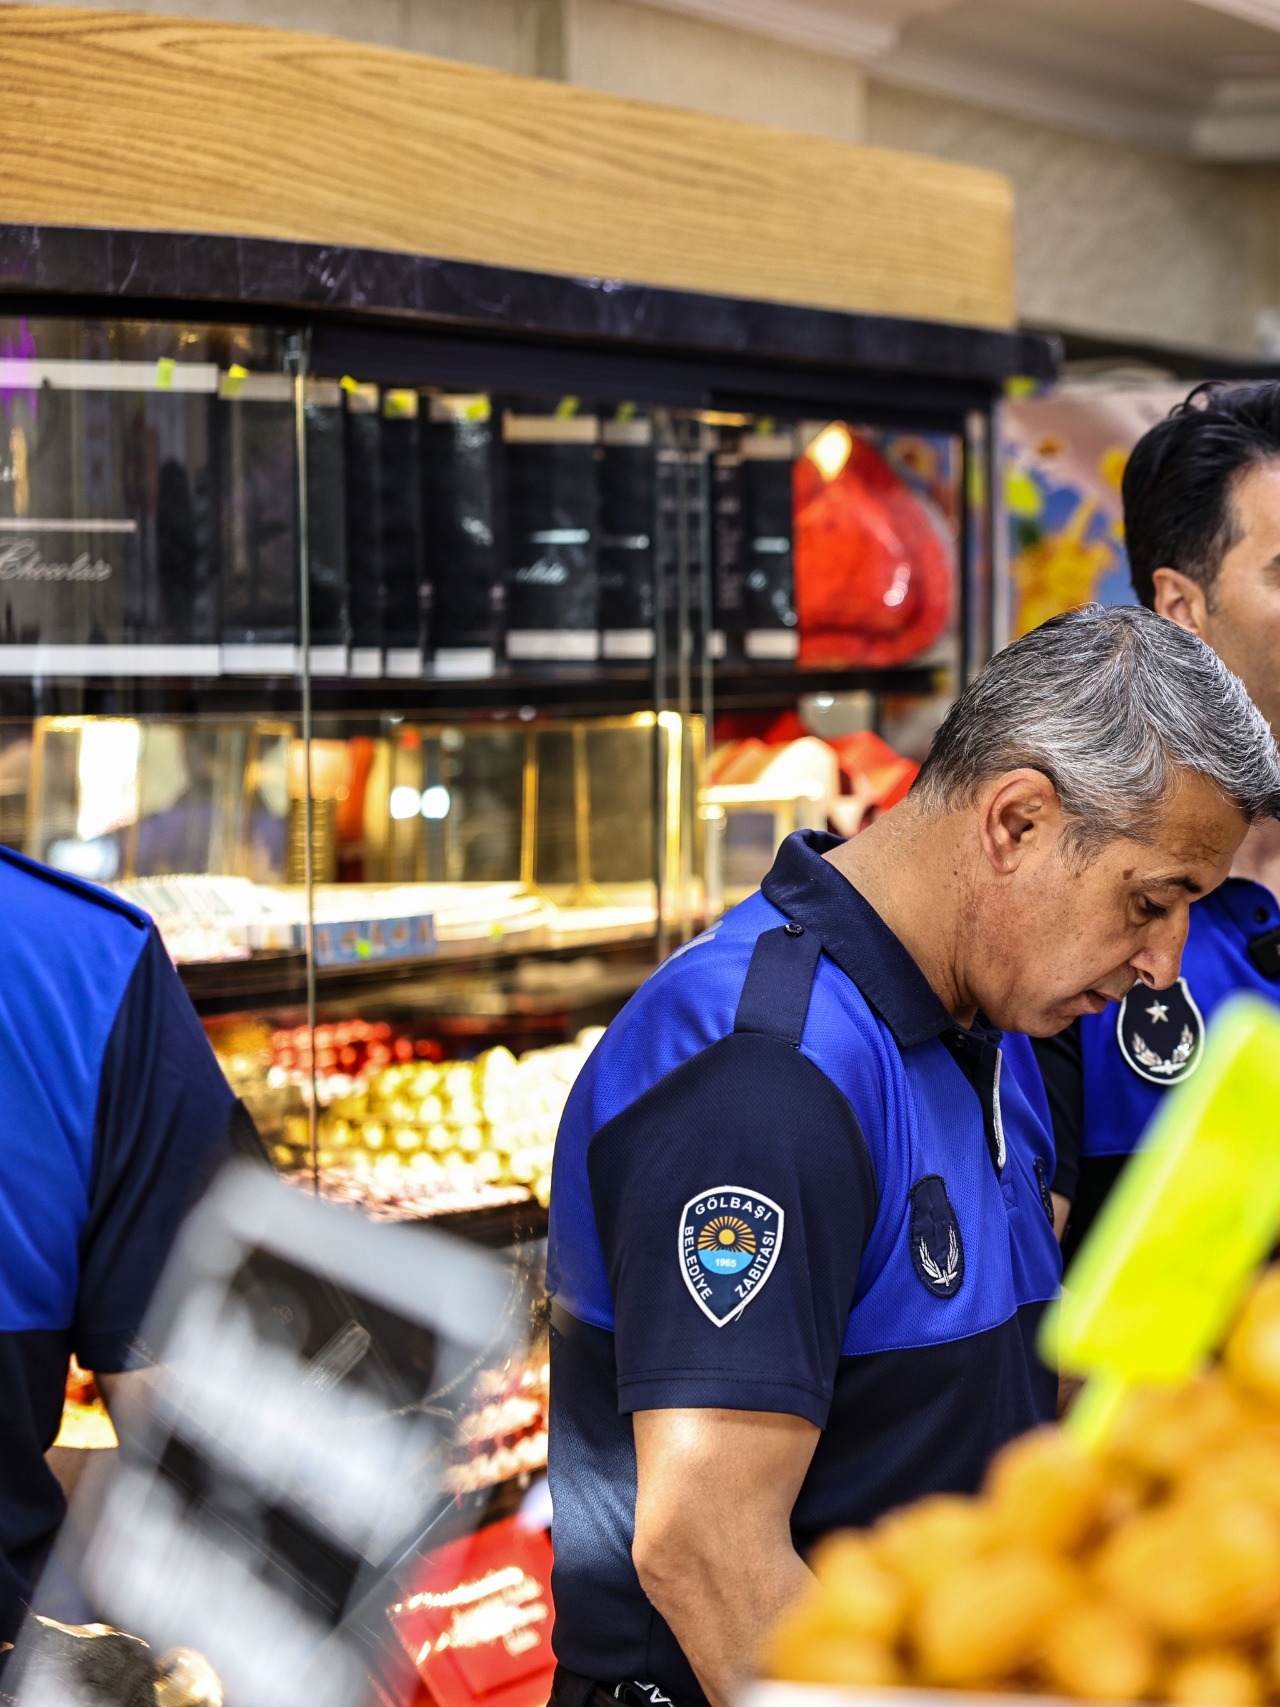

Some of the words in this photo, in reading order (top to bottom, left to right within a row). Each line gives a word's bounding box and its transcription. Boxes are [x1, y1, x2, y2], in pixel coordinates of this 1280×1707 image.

[695, 1196, 773, 1222] GÖLBAŞI
[684, 1226, 713, 1301] BELEDİYE
[714, 1258, 737, 1268] 1965
[734, 1230, 776, 1298] ZABITASI
